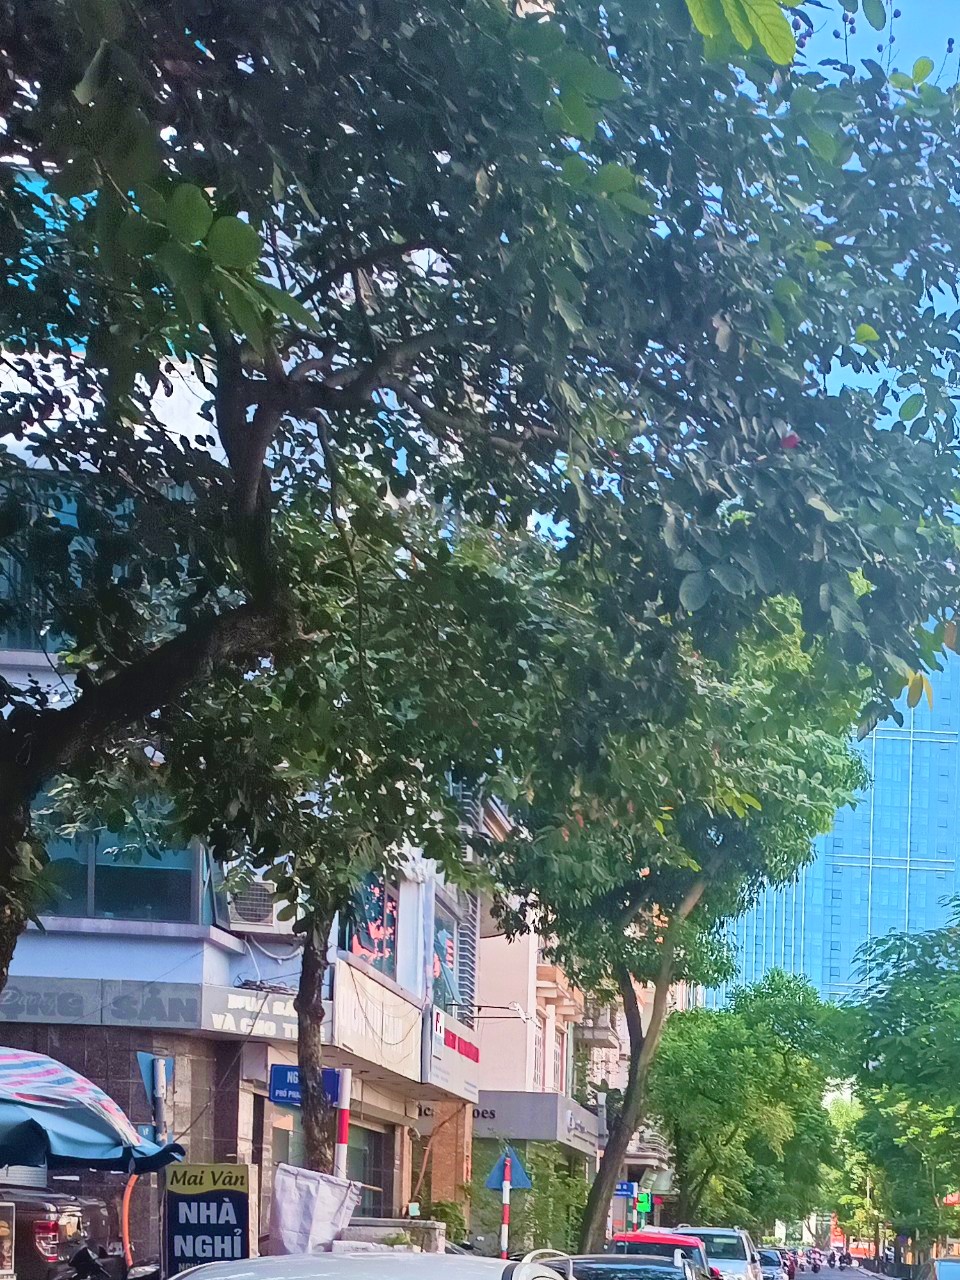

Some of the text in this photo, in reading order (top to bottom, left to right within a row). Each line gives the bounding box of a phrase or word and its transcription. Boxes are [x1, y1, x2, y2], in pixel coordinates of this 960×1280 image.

[472, 1108, 496, 1120] oes
[170, 1170, 246, 1186] Mai Vân
[178, 1197, 238, 1225] NHÀ
[173, 1228, 243, 1258] NGHỈ
